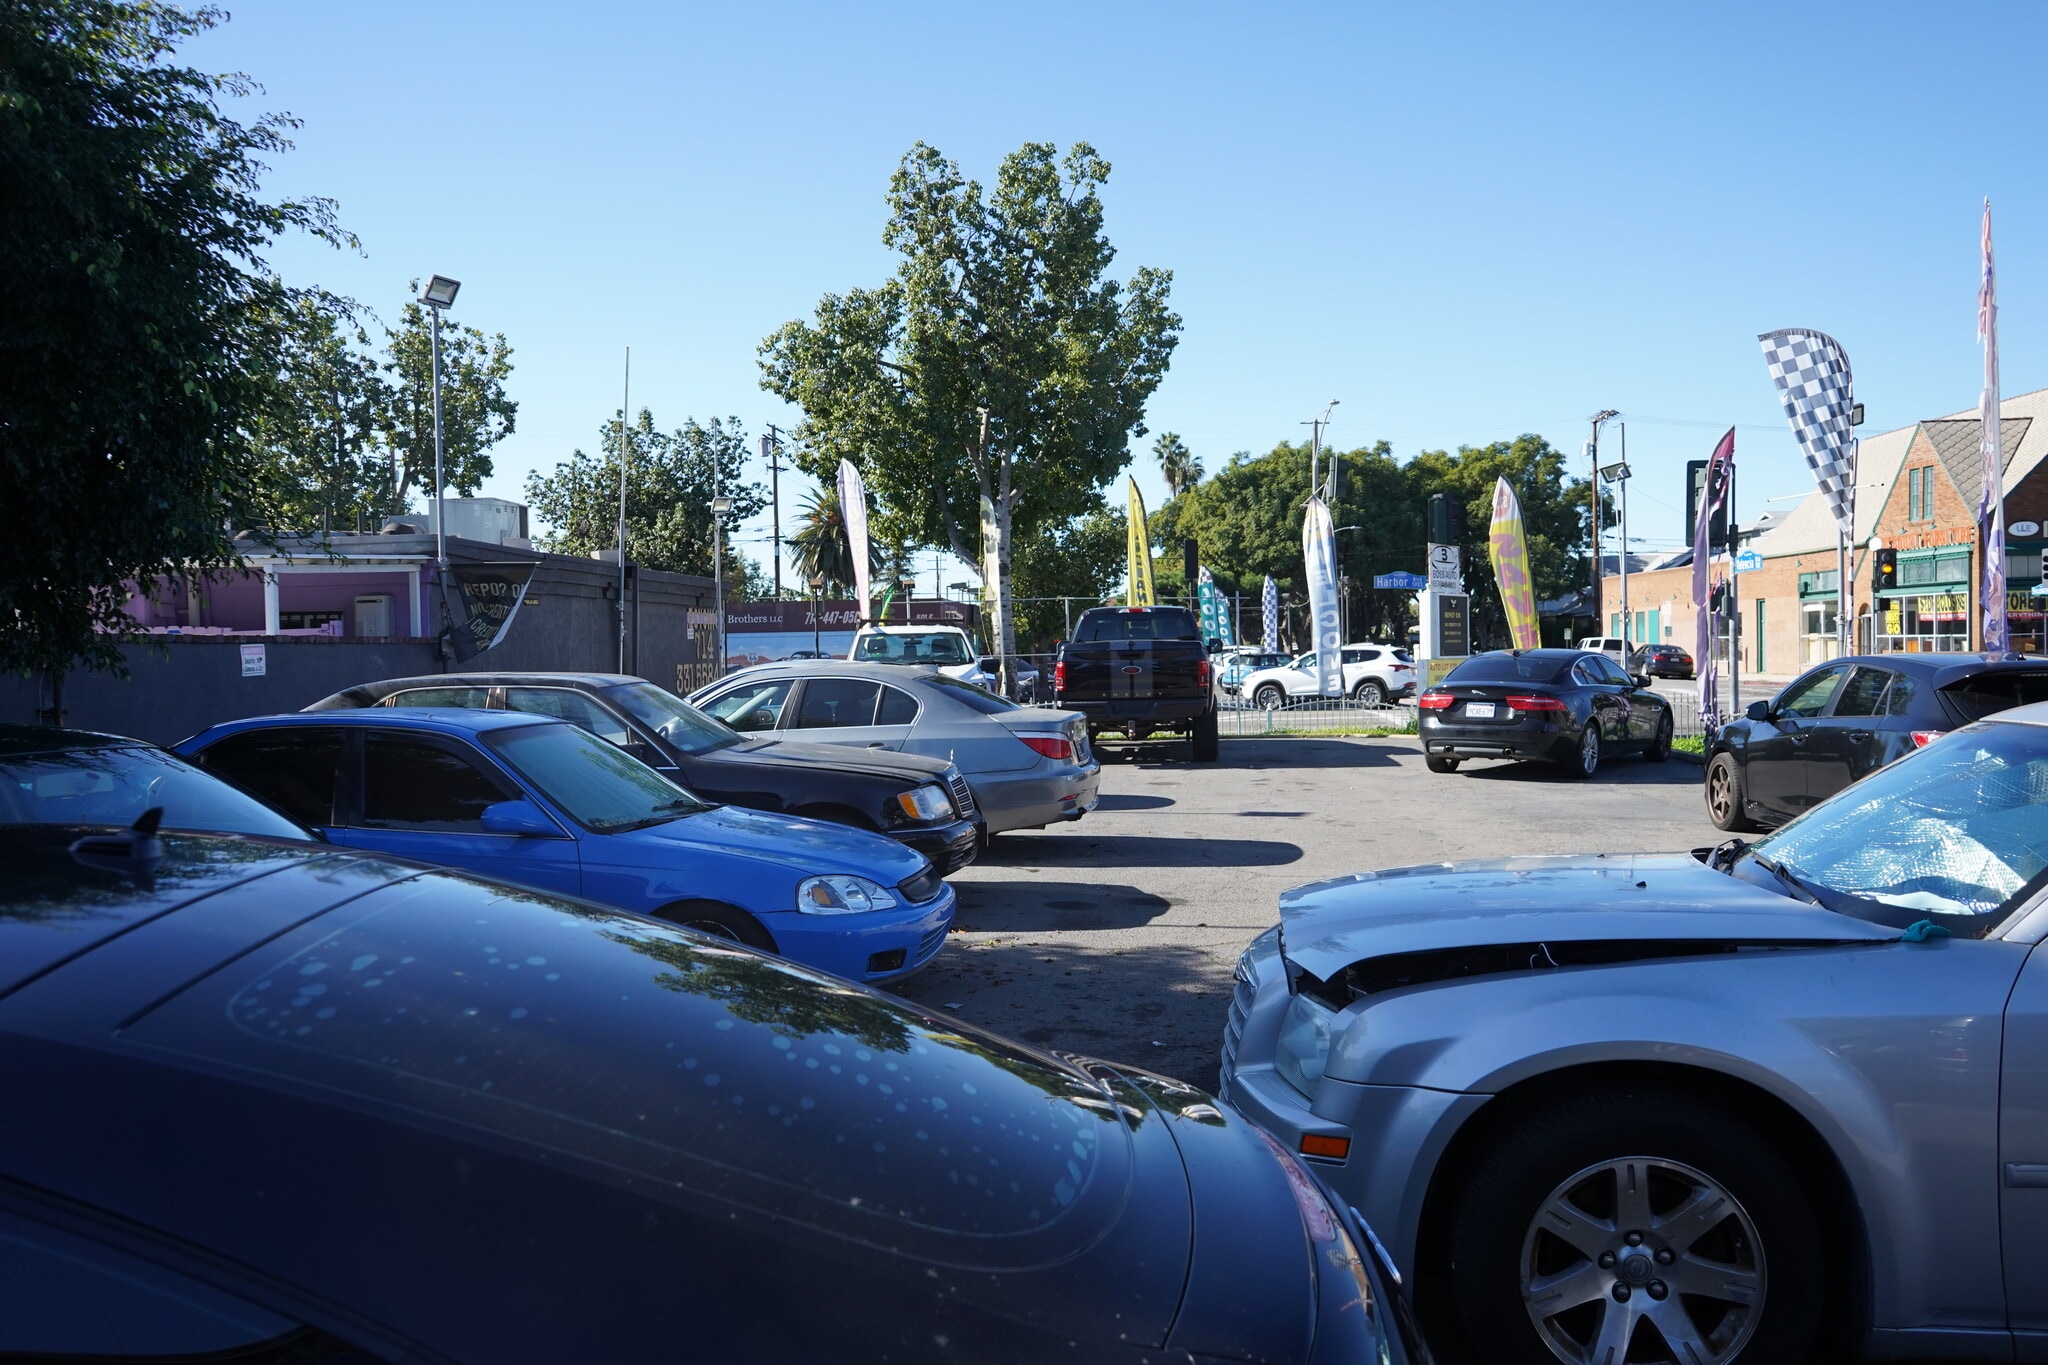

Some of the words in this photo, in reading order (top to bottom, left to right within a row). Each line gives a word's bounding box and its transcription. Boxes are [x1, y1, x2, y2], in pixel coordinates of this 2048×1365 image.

[1377, 577, 1408, 587] Harbor
[464, 583, 507, 597] REPO?
[728, 614, 767, 623] Brothers
[694, 631, 713, 659] 714
[1430, 662, 1441, 671] AUTO
